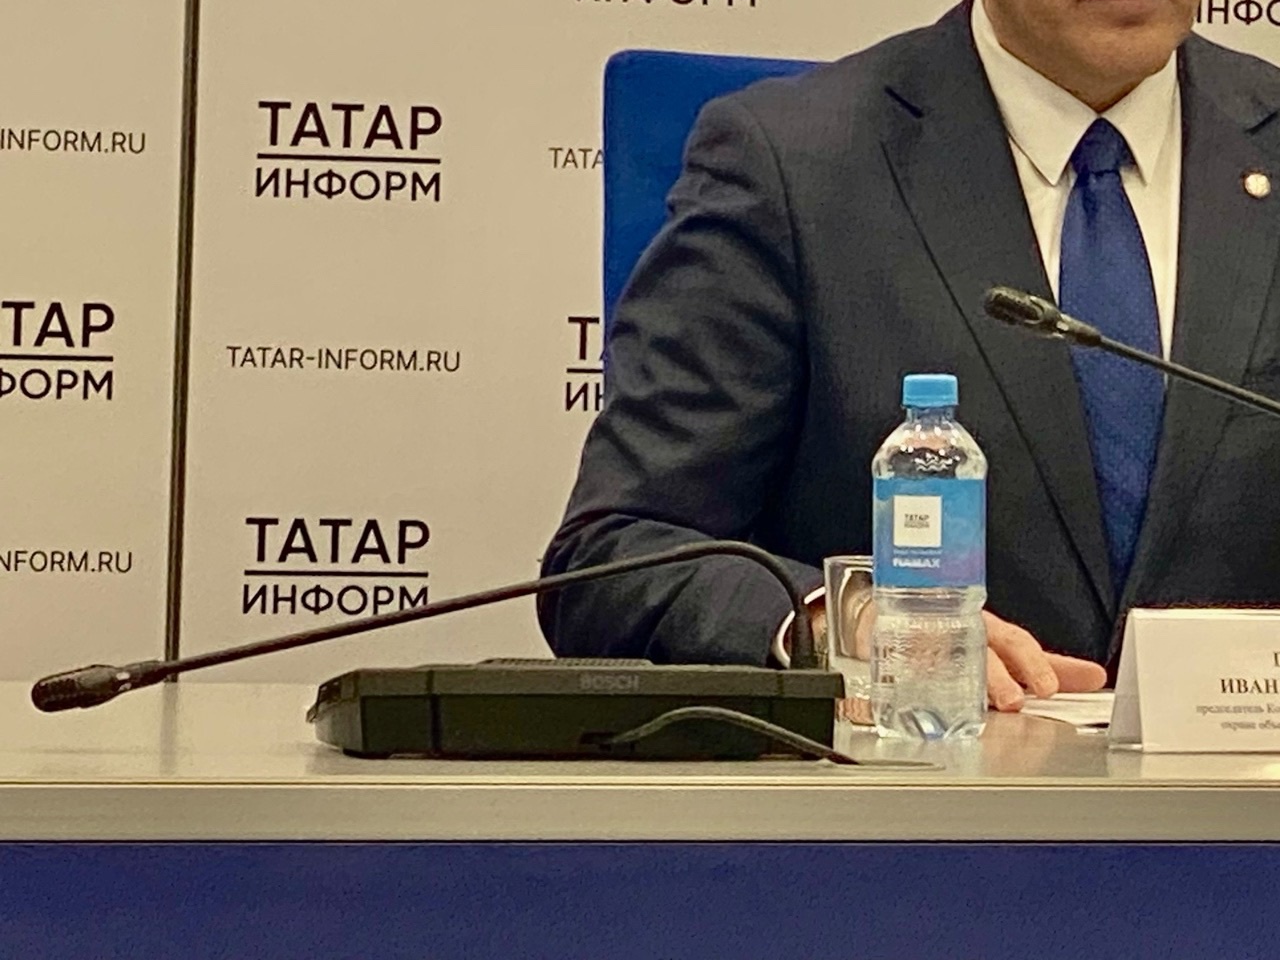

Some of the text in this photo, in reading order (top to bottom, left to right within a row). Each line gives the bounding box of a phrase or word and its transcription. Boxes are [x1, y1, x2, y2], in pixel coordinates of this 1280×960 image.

[0, 128, 146, 154] INFORM.RU
[258, 100, 442, 151] ТАТАР
[255, 167, 441, 203] ИНФОРМ
[1, 300, 115, 348] ТАР
[567, 316, 604, 360] Т
[226, 345, 460, 372] TATAR-INFORM.RU
[245, 517, 430, 565] ТАТАР
[243, 584, 428, 616] ИНФОРМ
[1220, 677, 1279, 695] ИВАН
